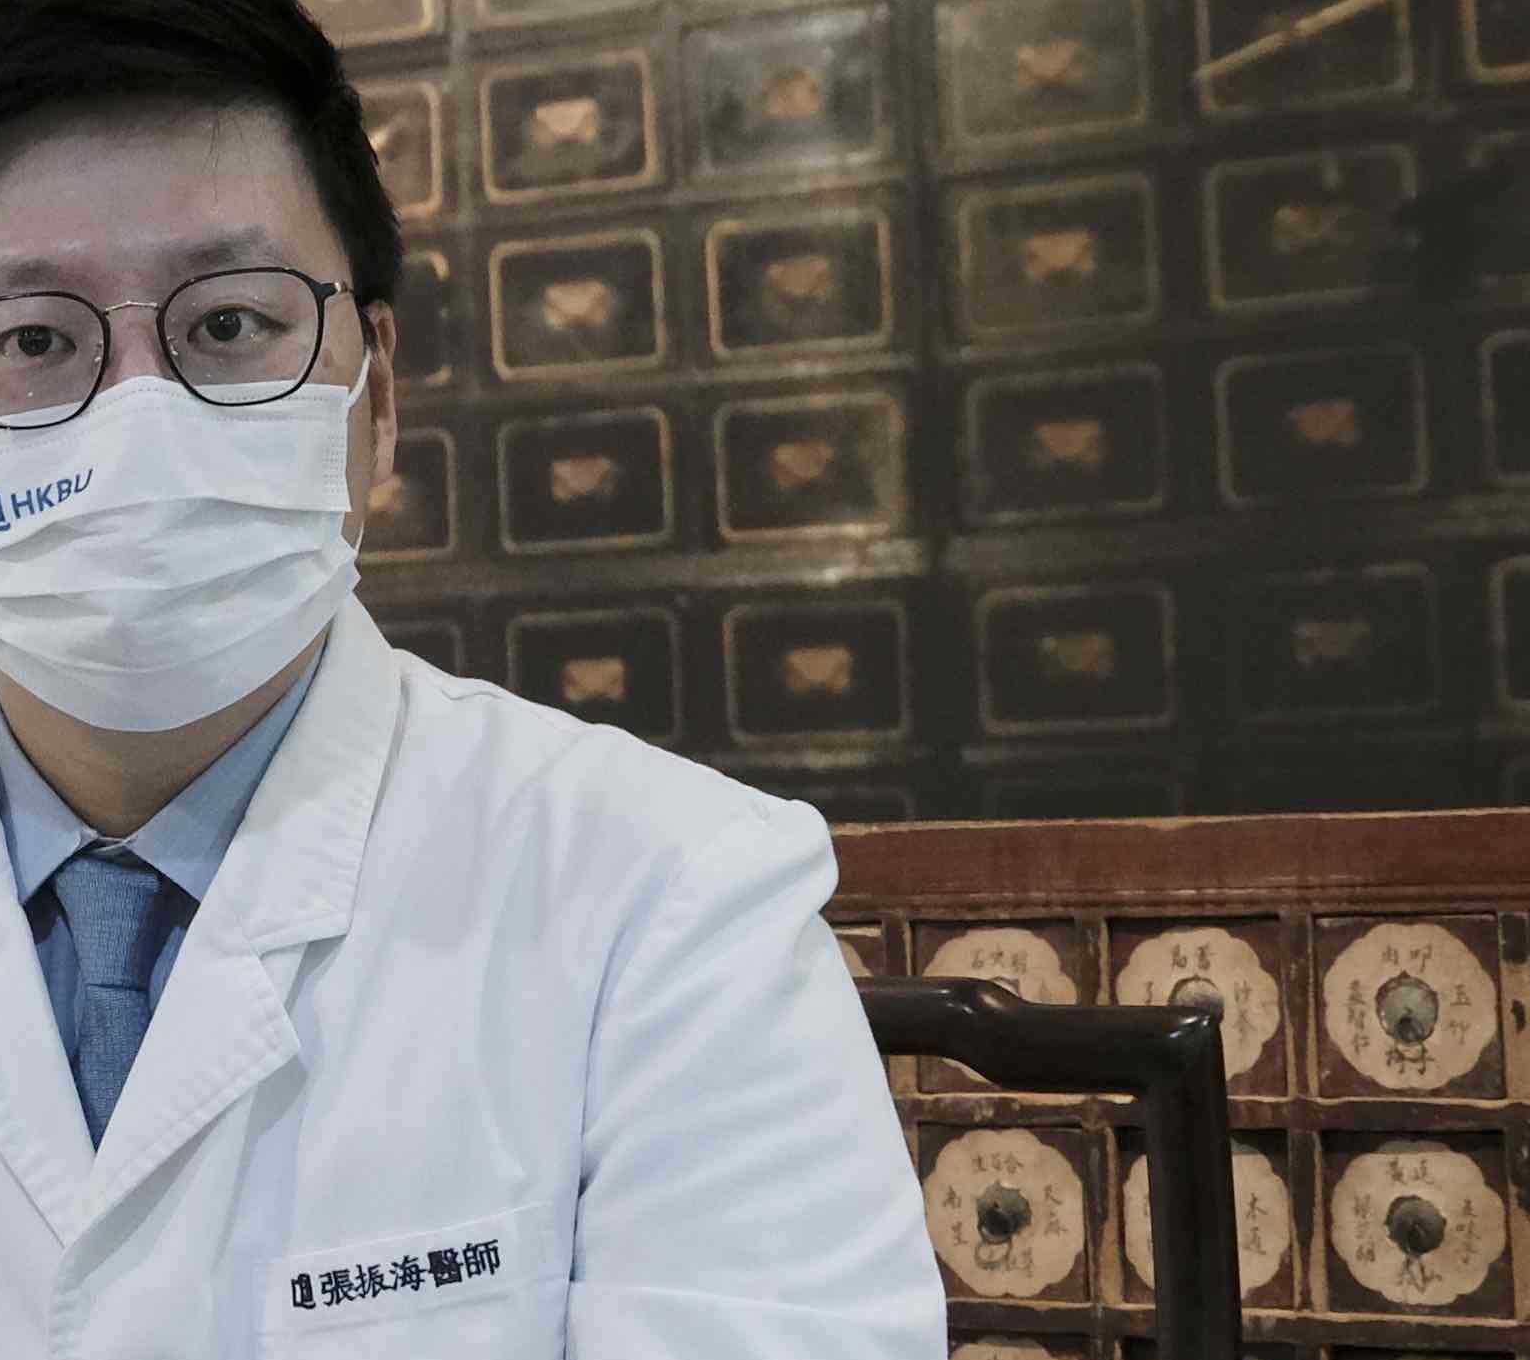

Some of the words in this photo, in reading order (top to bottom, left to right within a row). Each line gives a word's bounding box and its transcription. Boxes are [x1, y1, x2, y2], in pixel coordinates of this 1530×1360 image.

[11, 468, 94, 520] HKBU
[321, 1238, 501, 1307] 張振海醫師
